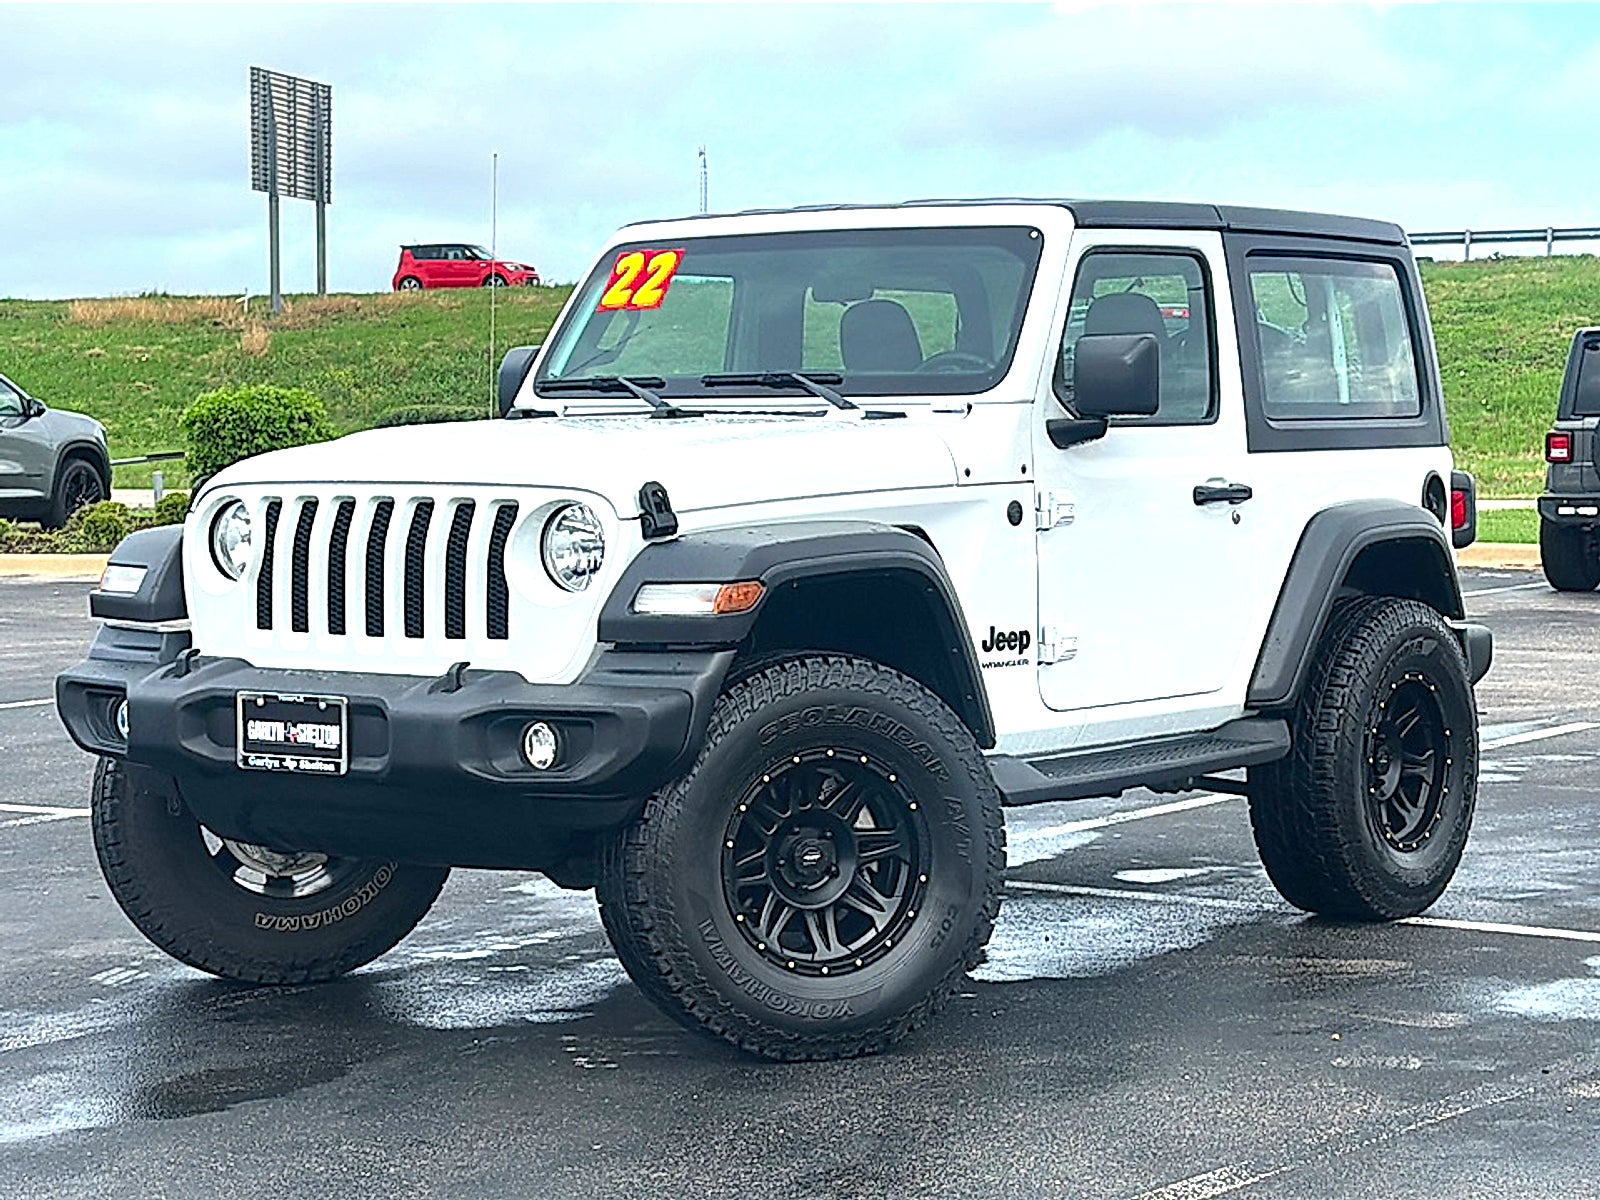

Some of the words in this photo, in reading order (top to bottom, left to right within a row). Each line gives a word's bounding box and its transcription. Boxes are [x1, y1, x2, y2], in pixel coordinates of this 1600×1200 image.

[601, 251, 677, 308] 22
[981, 625, 1030, 655] Jeep
[247, 720, 285, 742] GARLYN
[296, 723, 340, 745] SHELTON
[699, 917, 854, 1019] YOKOHAMA
